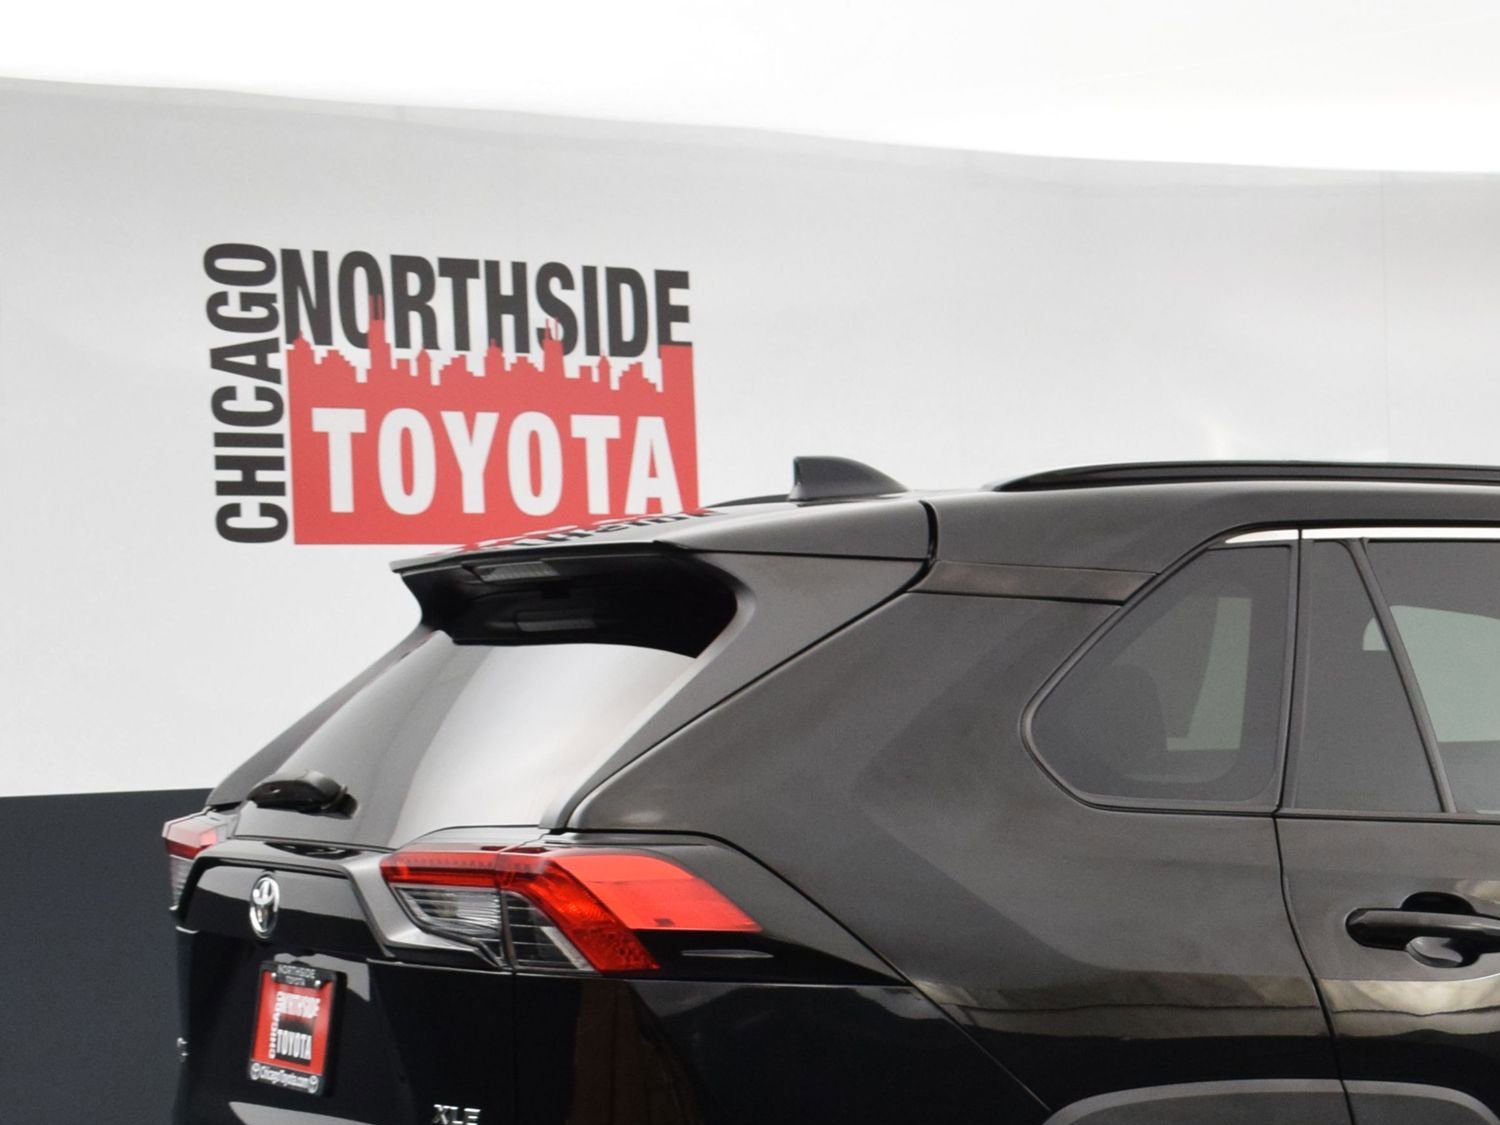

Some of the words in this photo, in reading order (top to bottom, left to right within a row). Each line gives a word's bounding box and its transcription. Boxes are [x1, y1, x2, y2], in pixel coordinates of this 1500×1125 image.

[281, 247, 693, 359] NORTHSIDE
[203, 242, 288, 544] CHICAGO
[311, 406, 684, 516] TOYOTA
[276, 1028, 313, 1060] TOYOTA
